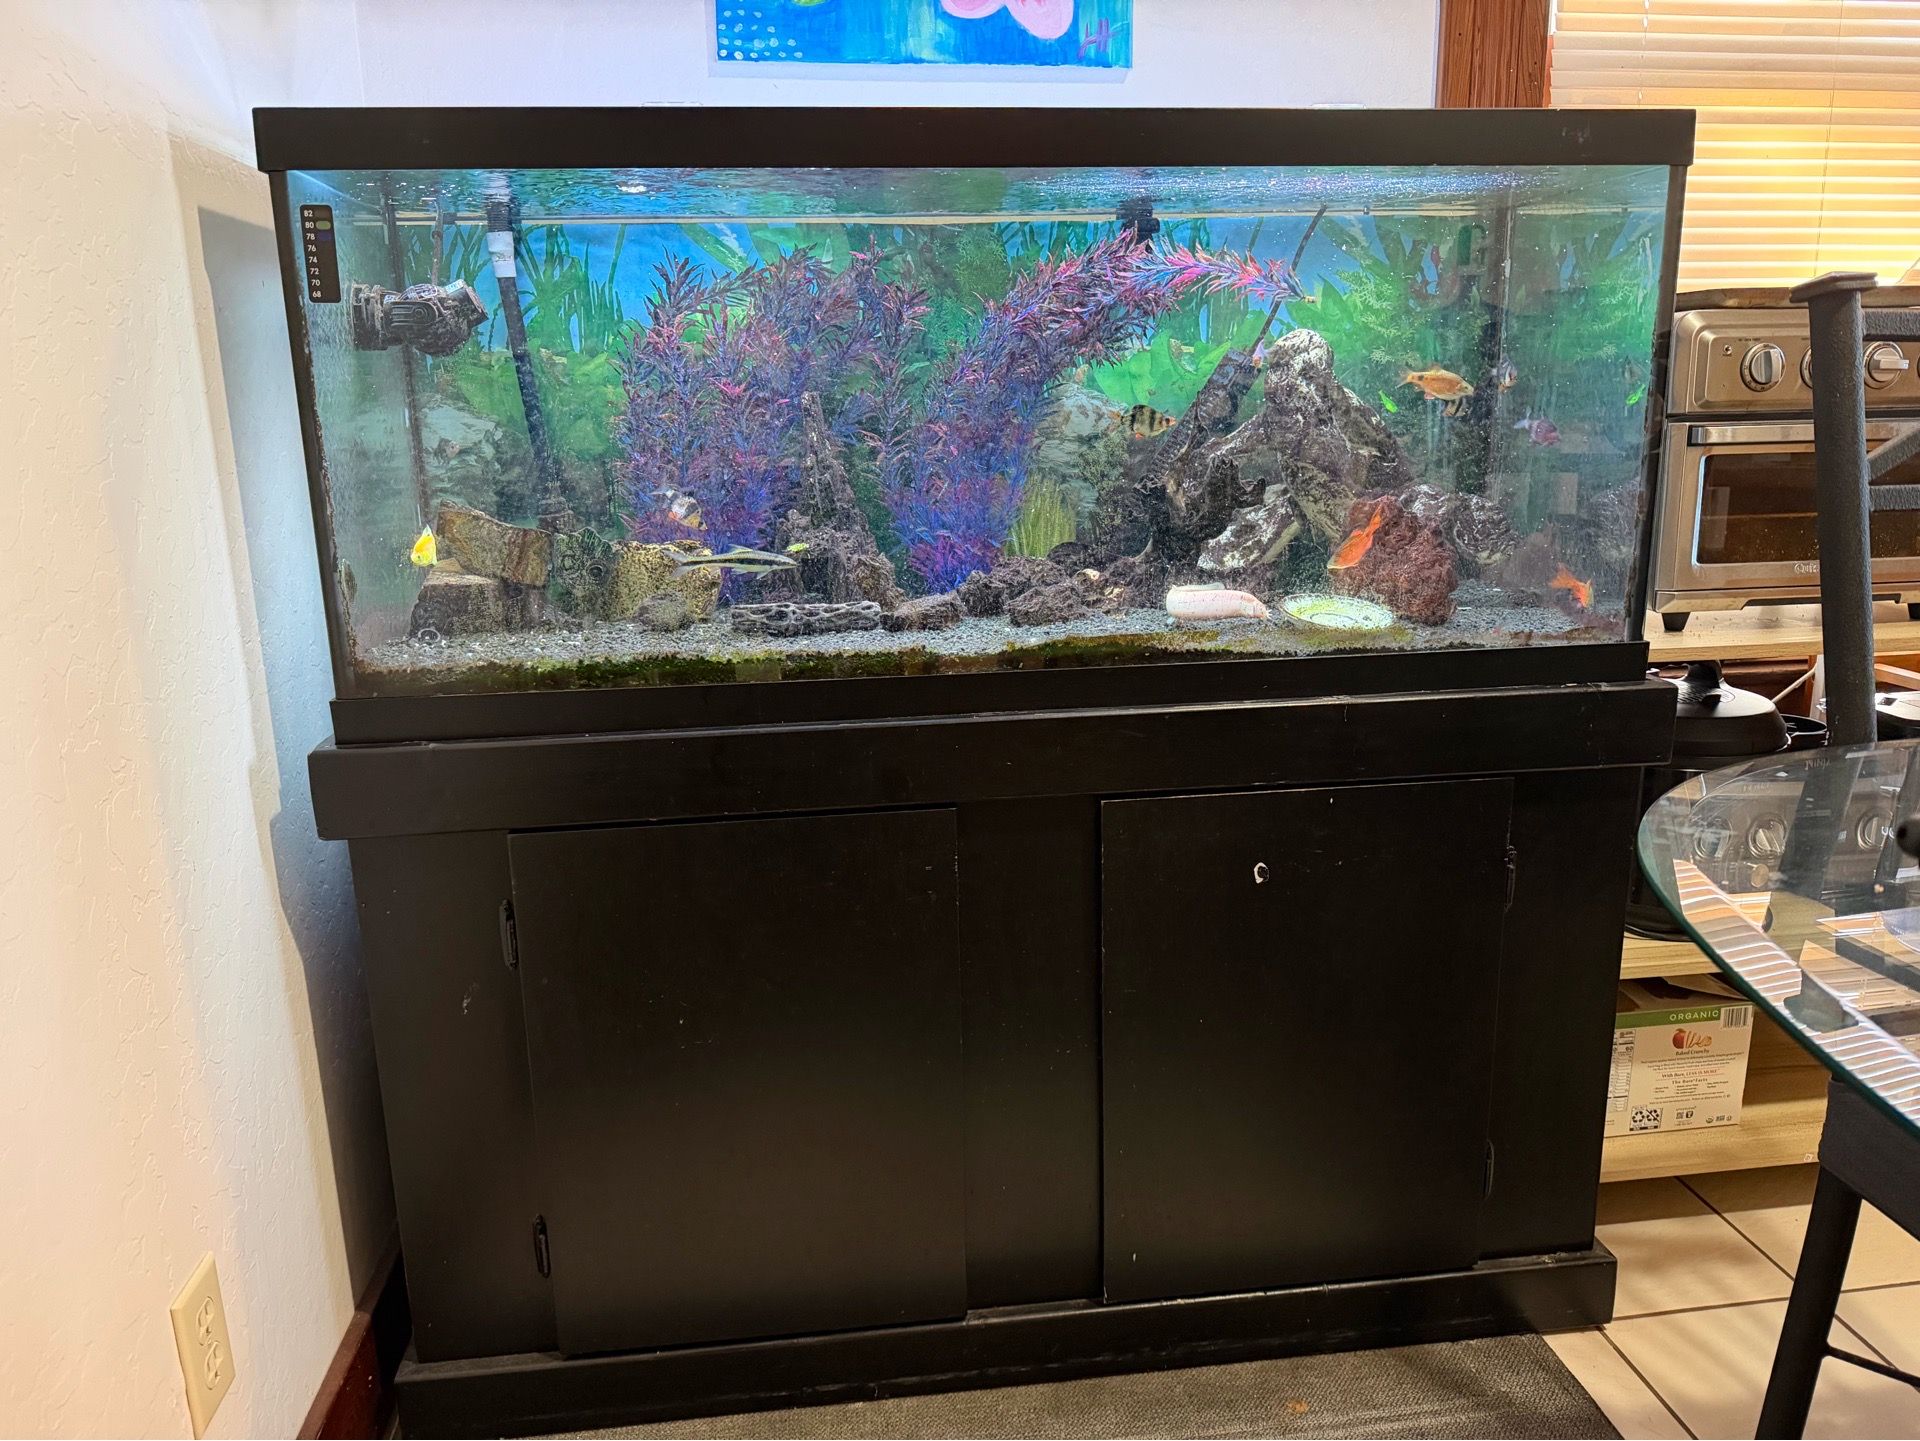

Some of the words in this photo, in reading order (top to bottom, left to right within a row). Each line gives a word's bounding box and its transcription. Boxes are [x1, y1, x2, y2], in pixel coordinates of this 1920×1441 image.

[304, 209, 313, 217] 82
[305, 221, 314, 229] 80
[1669, 1010, 1719, 1021] ORGANIC
